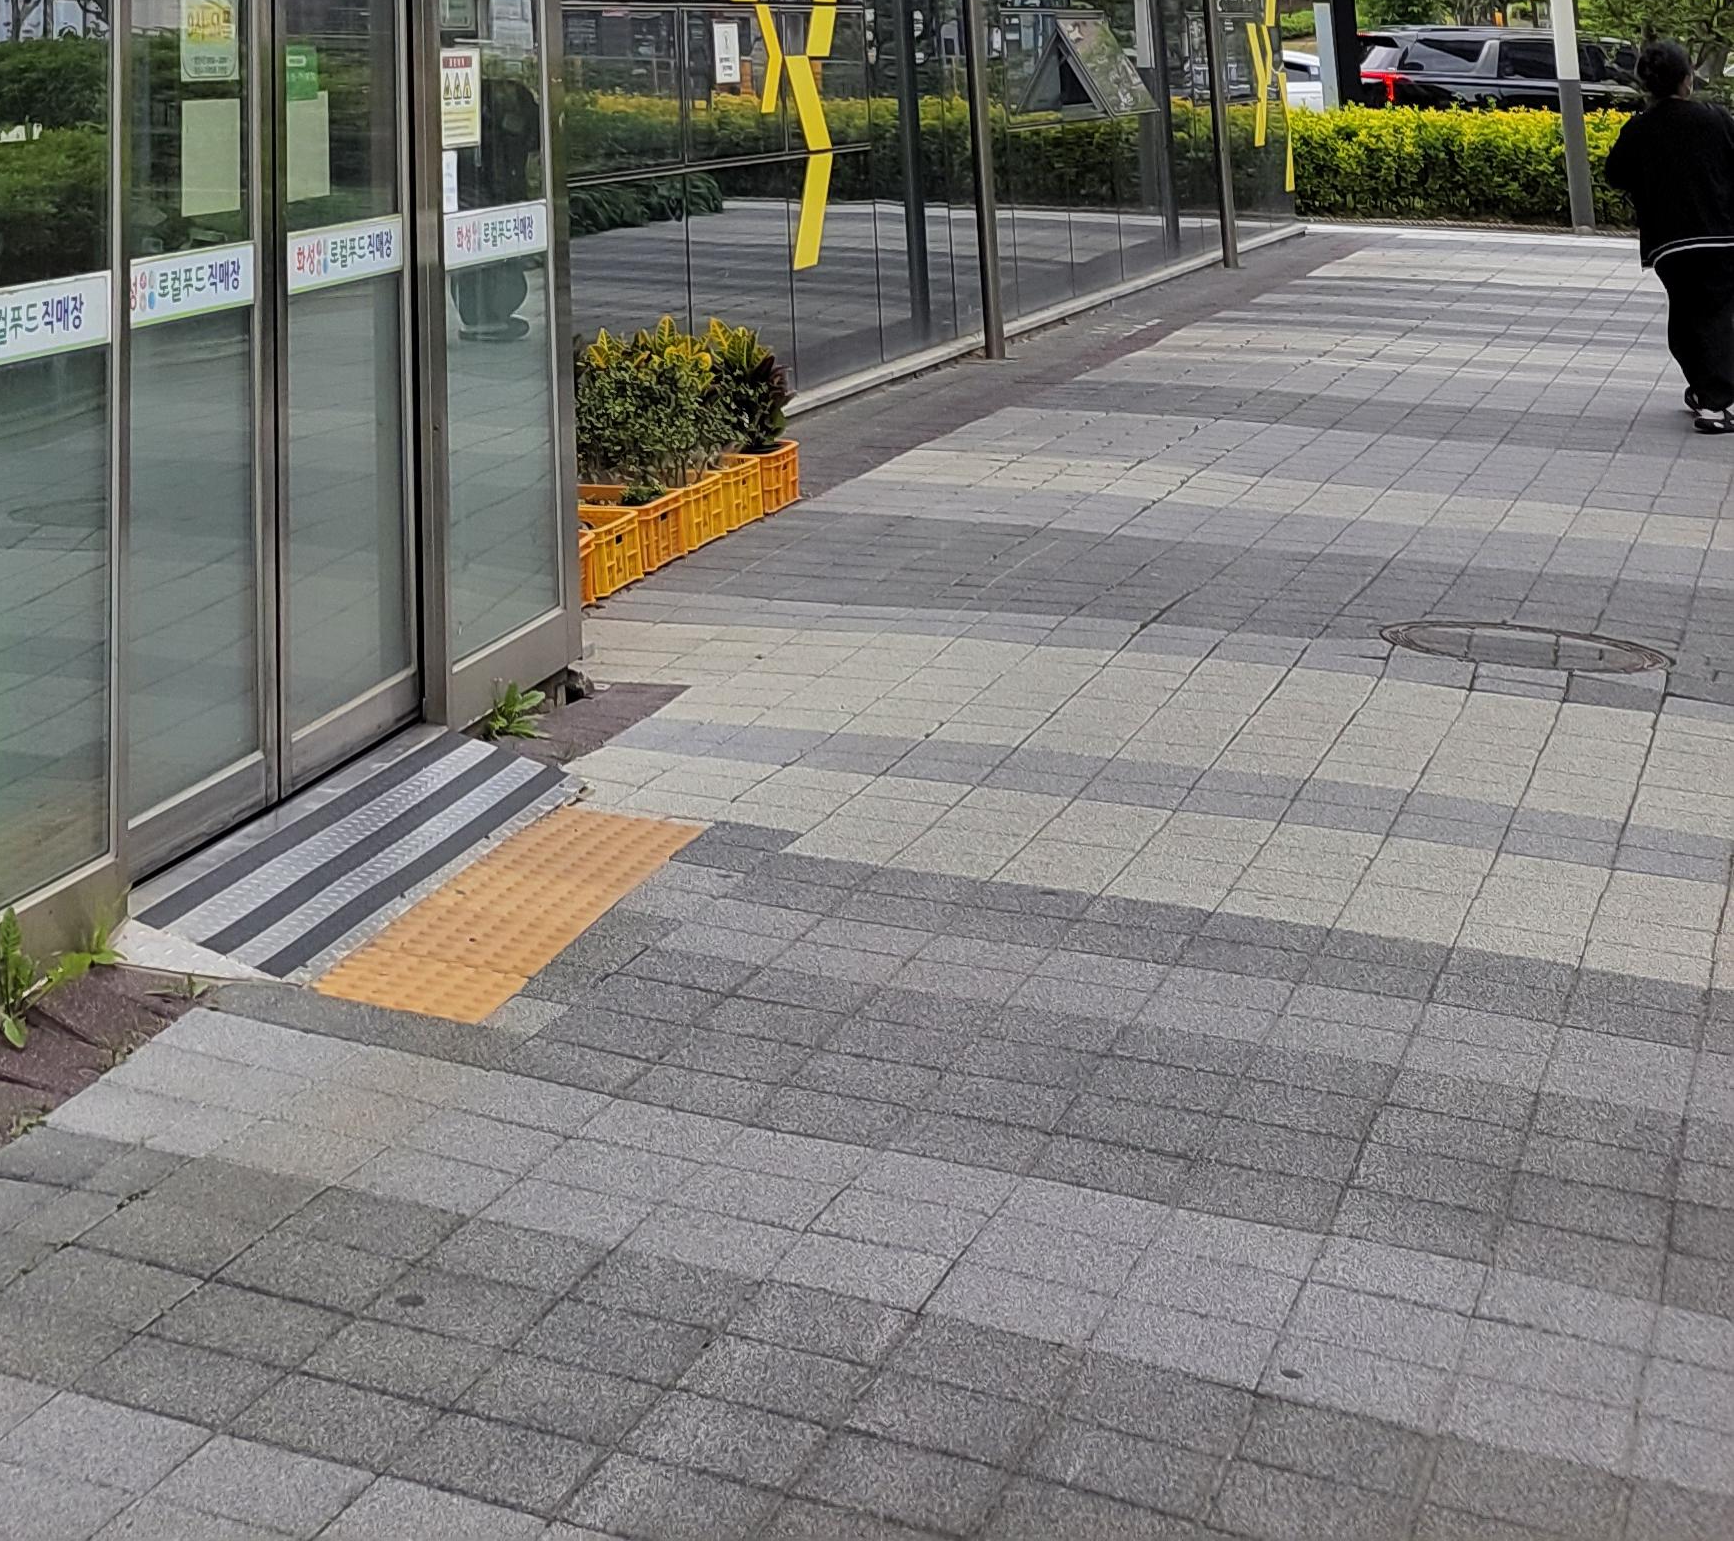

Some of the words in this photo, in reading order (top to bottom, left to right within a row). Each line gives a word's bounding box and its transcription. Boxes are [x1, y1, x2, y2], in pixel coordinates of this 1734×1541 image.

[296, 242, 317, 276] 화성
[329, 236, 366, 269] 로컬푸드
[366, 228, 393, 261] 직매장
[482, 218, 512, 248] 로컬푸드
[512, 213, 534, 244] 직매장
[157, 266, 207, 304] 로컬푸드
[207, 257, 241, 294] 직매장
[41, 293, 85, 335] 직매장
